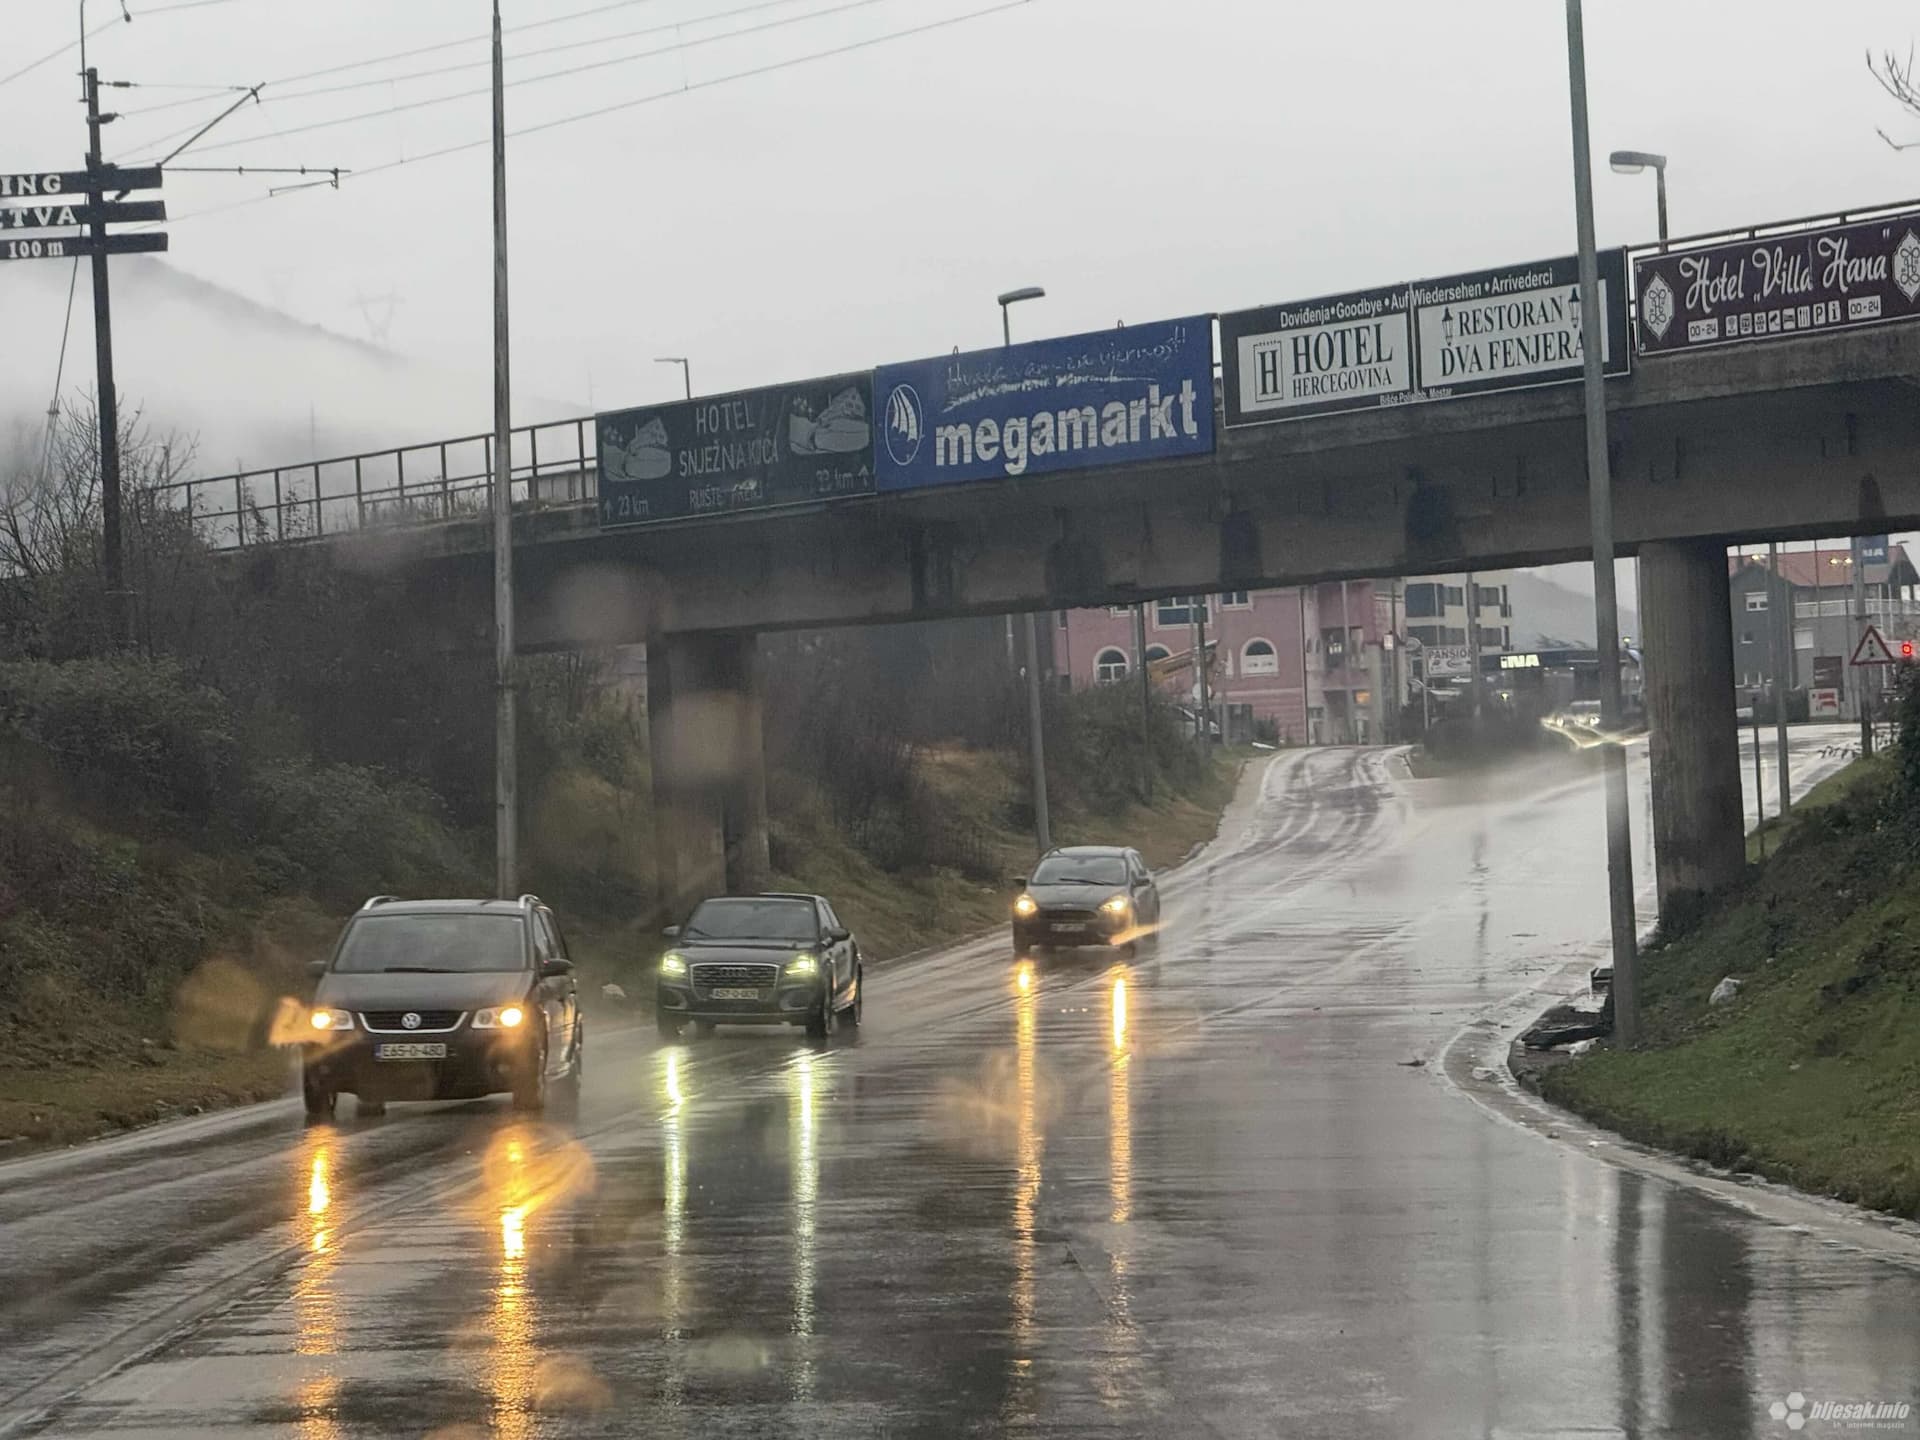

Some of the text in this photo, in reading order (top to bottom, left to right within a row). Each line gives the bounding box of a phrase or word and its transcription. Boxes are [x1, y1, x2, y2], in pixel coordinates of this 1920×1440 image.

[0, 206, 77, 228] TVA
[9, 240, 64, 258] 100 m
[1336, 298, 1382, 318] Goodbye
[1391, 292, 1410, 309] Auf
[1411, 282, 1481, 305] Wiedersehen
[1491, 268, 1552, 293] Arrivederci
[1679, 256, 1744, 313] Hotel
[1459, 295, 1563, 337] RESTORAN
[1291, 323, 1393, 375] HOTEL
[1440, 345, 1483, 376] DVA
[1258, 350, 1280, 395] H
[1293, 367, 1392, 398] HERCEGOVINA
[696, 402, 755, 434] HOTEL
[935, 379, 1198, 475] megamarkt
[679, 440, 746, 477] SNJEŽNA
[632, 494, 649, 515] km
